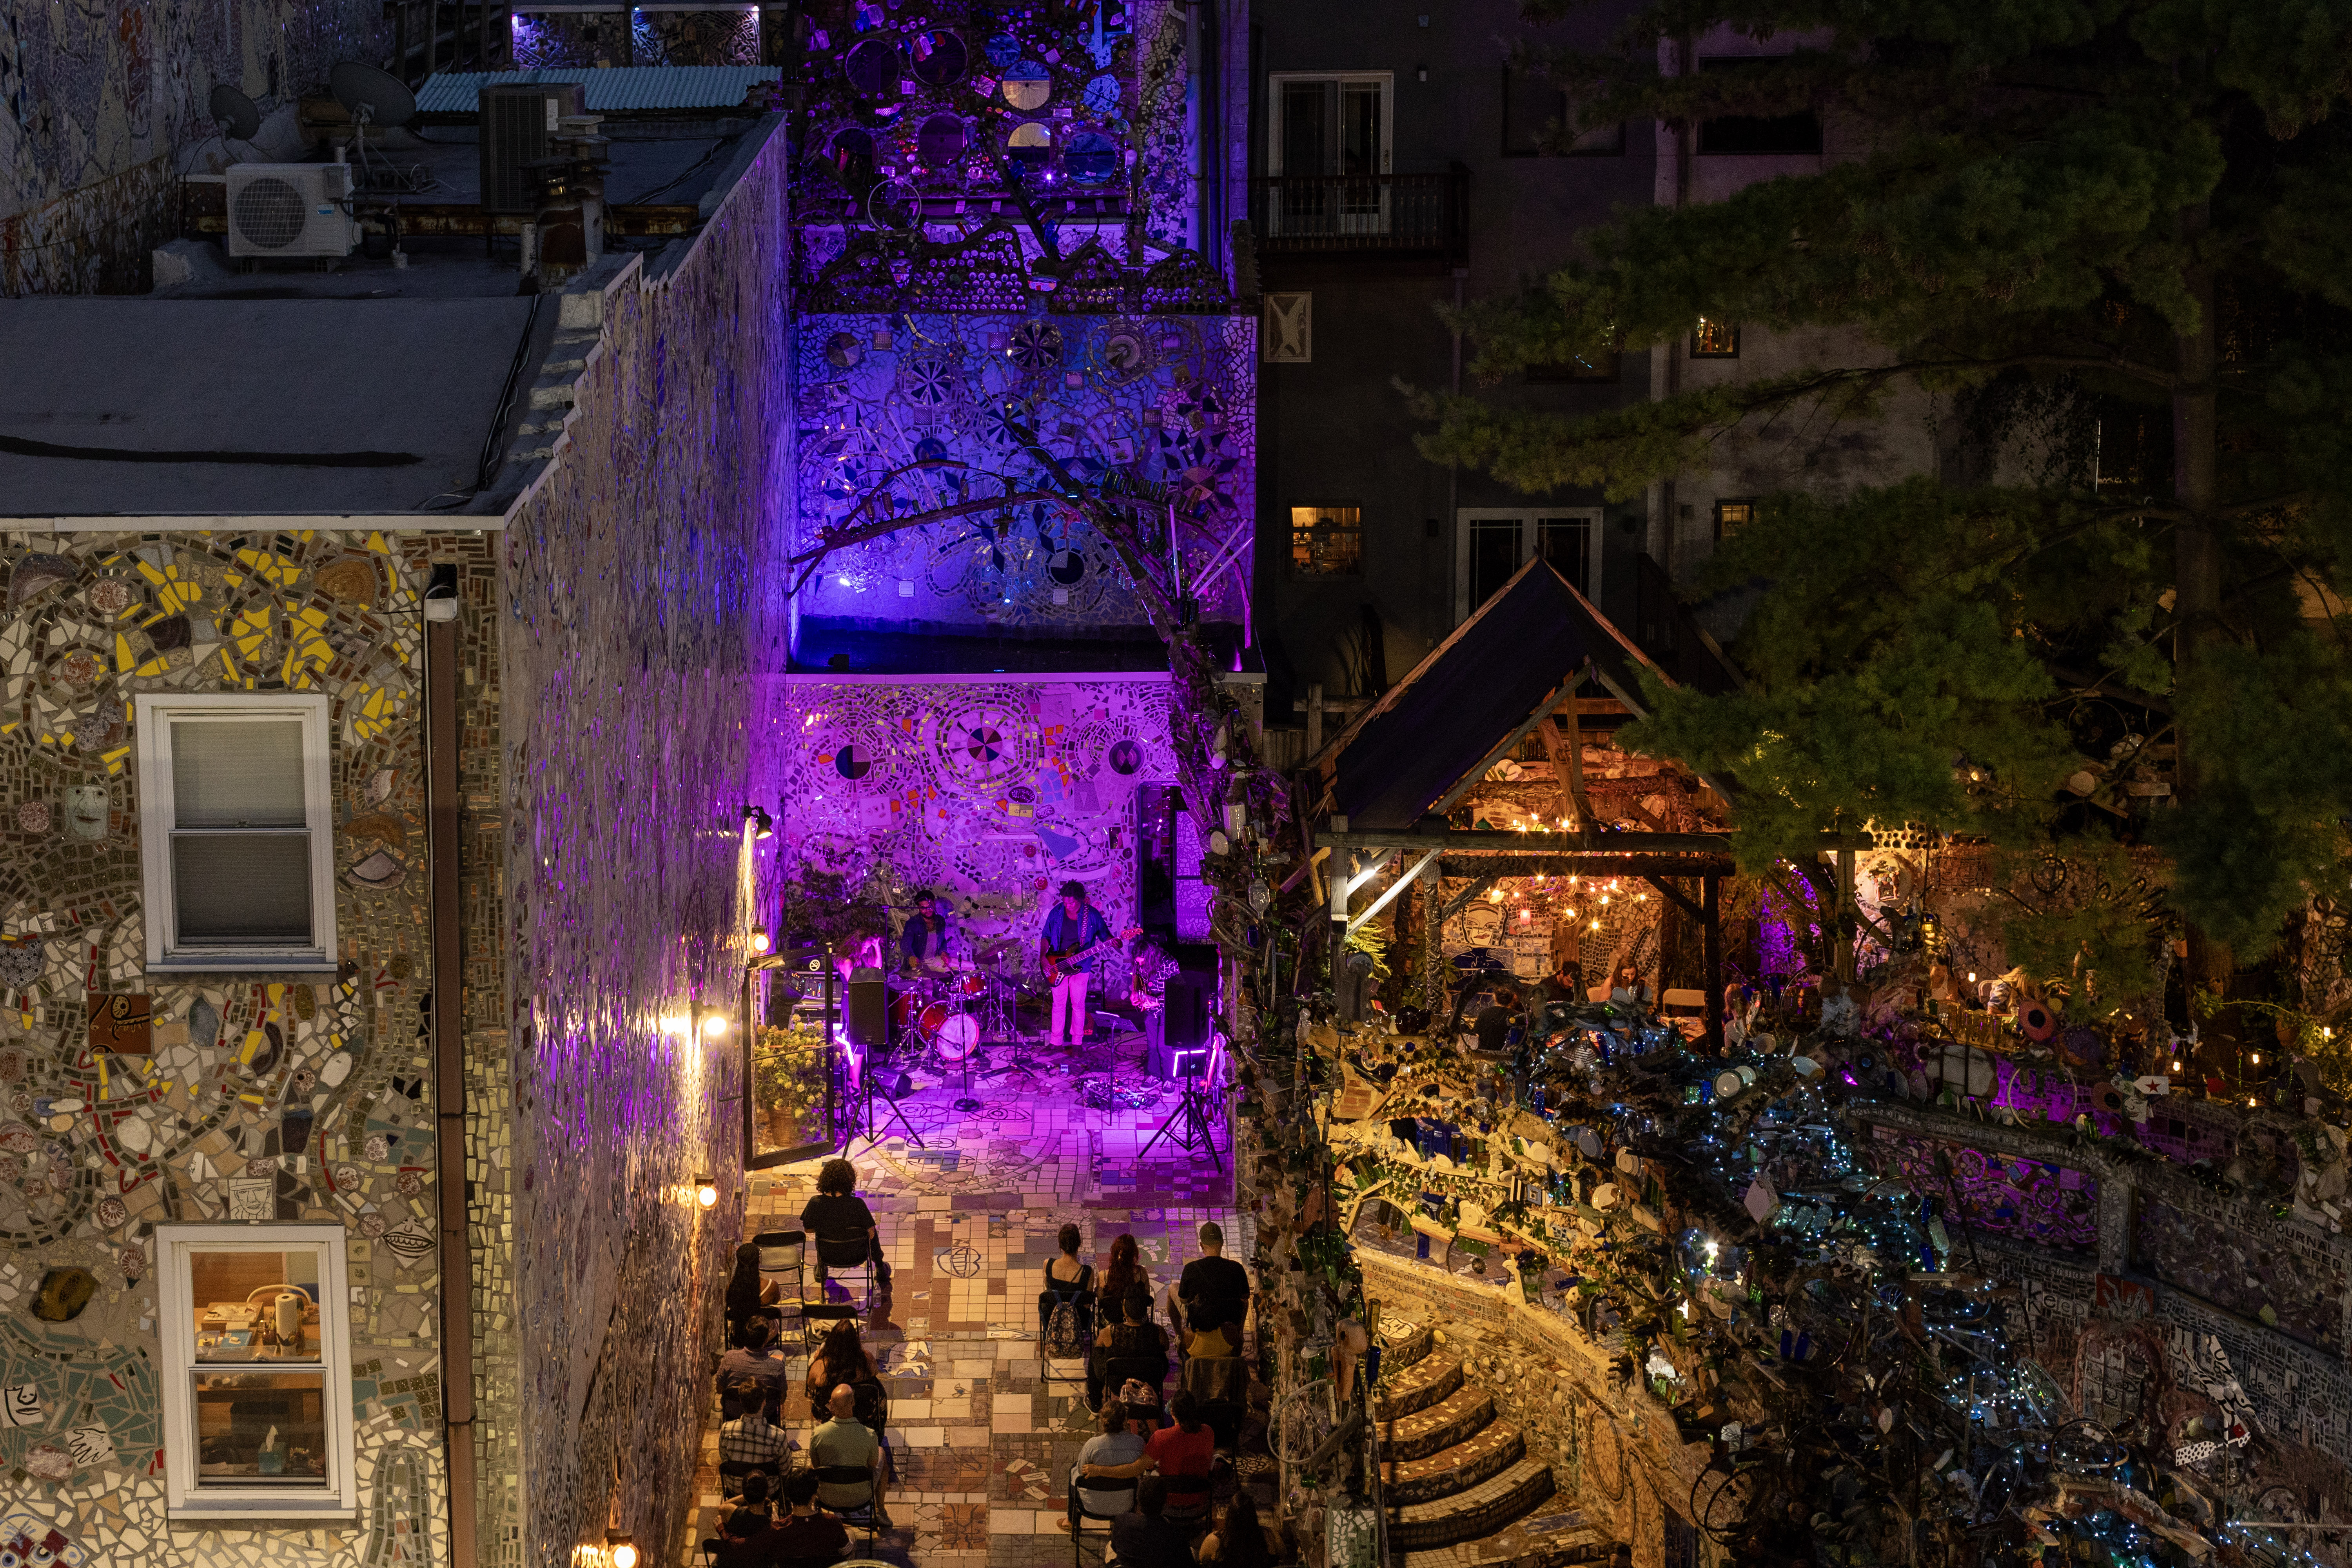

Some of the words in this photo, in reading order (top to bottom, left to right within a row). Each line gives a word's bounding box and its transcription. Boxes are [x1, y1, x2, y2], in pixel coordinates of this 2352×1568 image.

[2194, 1202, 2222, 1220] FOR
[2228, 1215, 2267, 1239] THEM
[2275, 1235, 2293, 1250] WE
[2301, 1245, 2341, 1269] NEED
[2266, 1218, 2352, 1259] JOURNALI
[1372, 1264, 1421, 1285] DEVELOPS
[1374, 1274, 1416, 1294] COMPLEX
[1425, 1294, 1448, 1307] TASK
[1457, 1305, 1468, 1315] OF
[2260, 1413, 2303, 1444] arried
